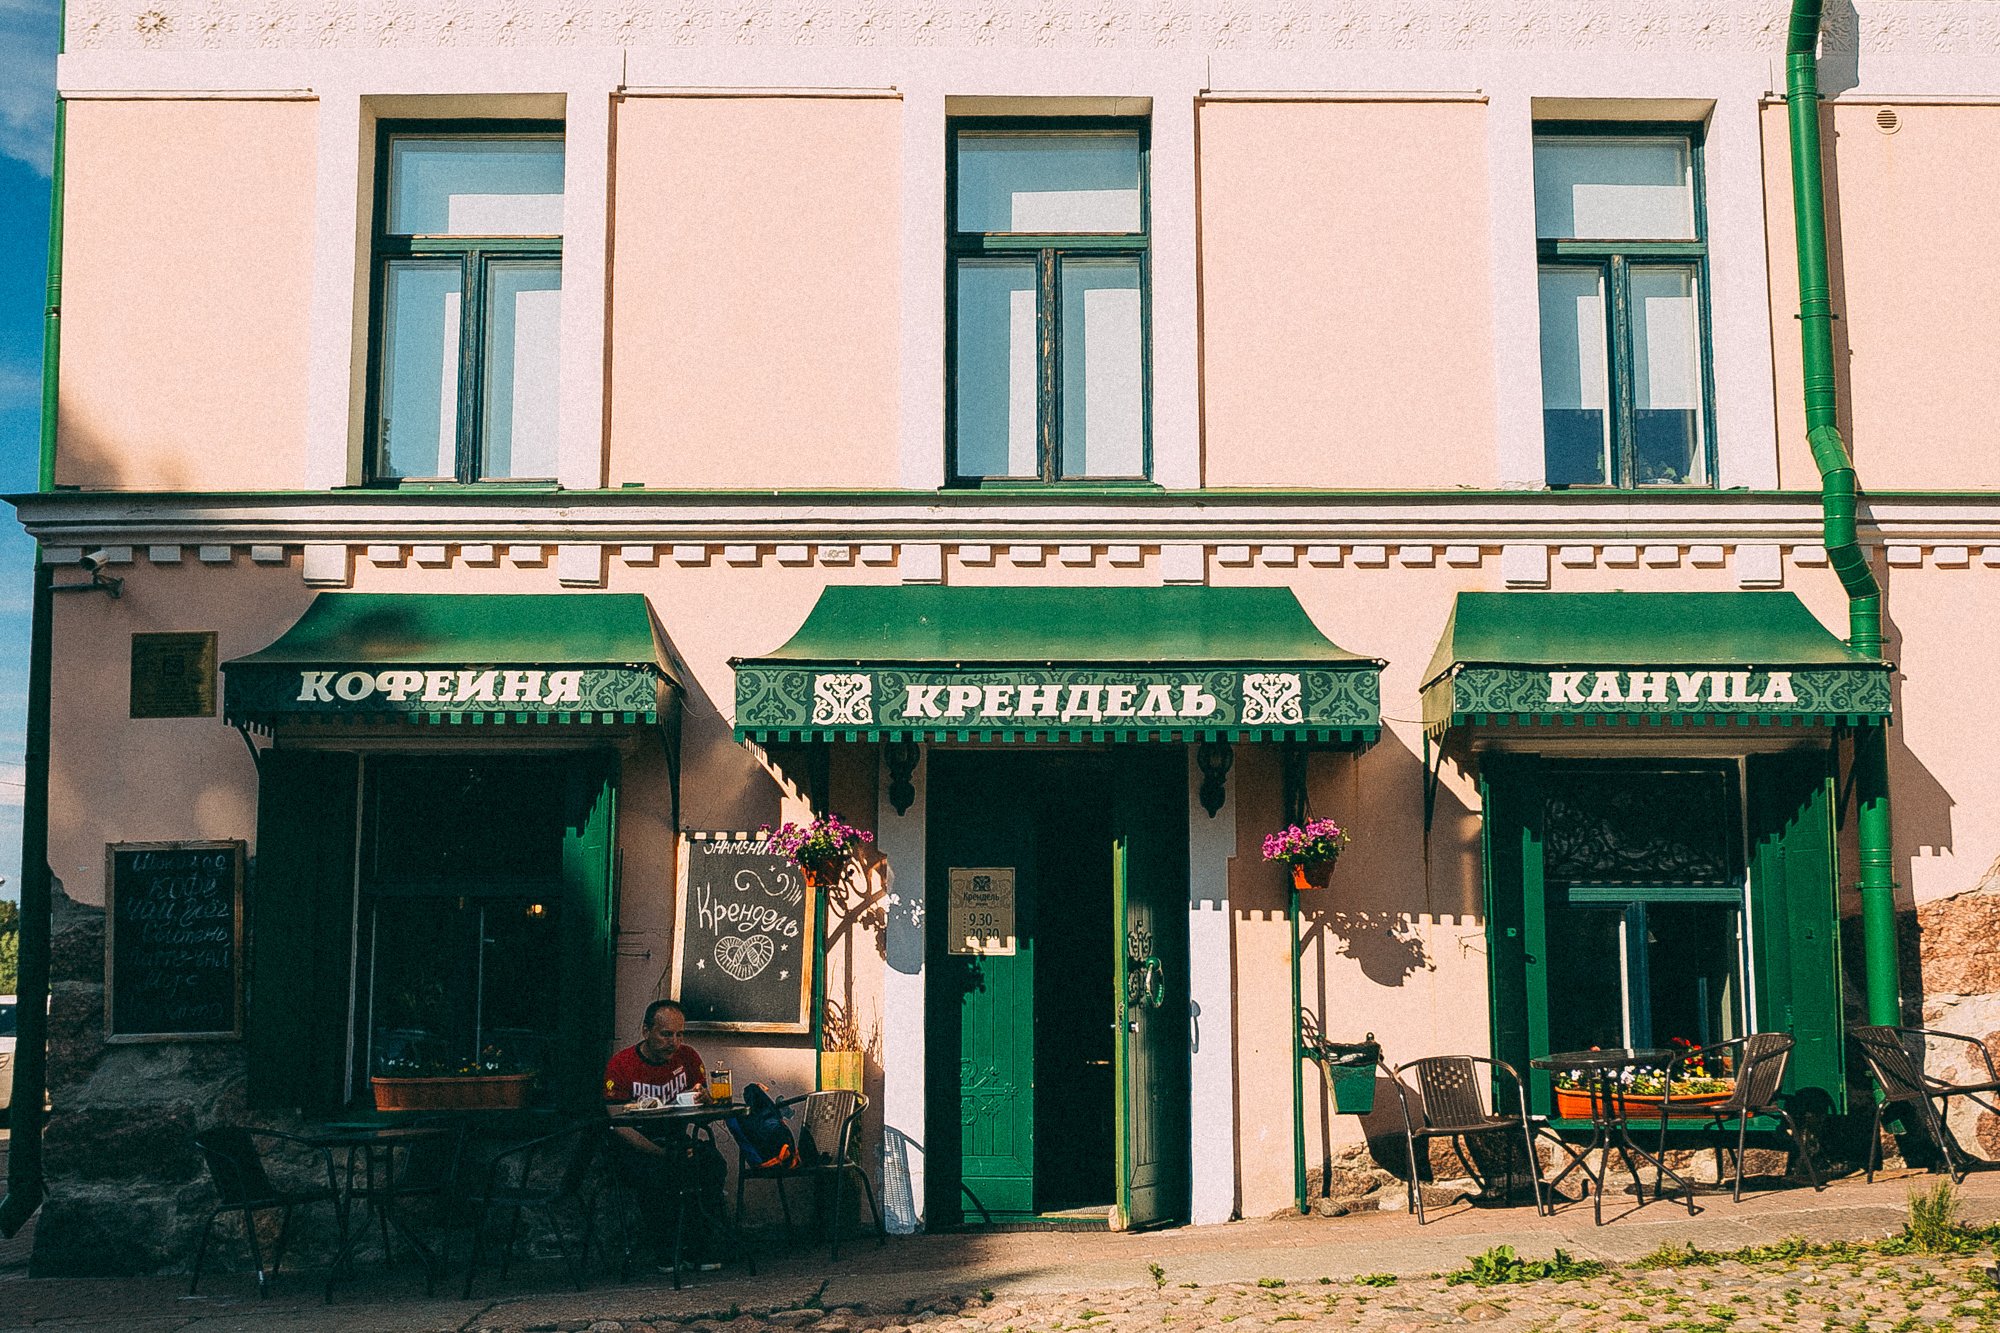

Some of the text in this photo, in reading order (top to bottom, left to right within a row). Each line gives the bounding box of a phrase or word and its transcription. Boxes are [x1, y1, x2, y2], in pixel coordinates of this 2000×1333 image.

[296, 663, 584, 704] КОФЕЙНЯ
[1546, 671, 1798, 703] KAHVILA
[902, 684, 1218, 722] КРЕНДЕЛЬ
[697, 882, 799, 937] Крендель
[963, 892, 1000, 903] Крендель
[969, 928, 1000, 941] 20.30
